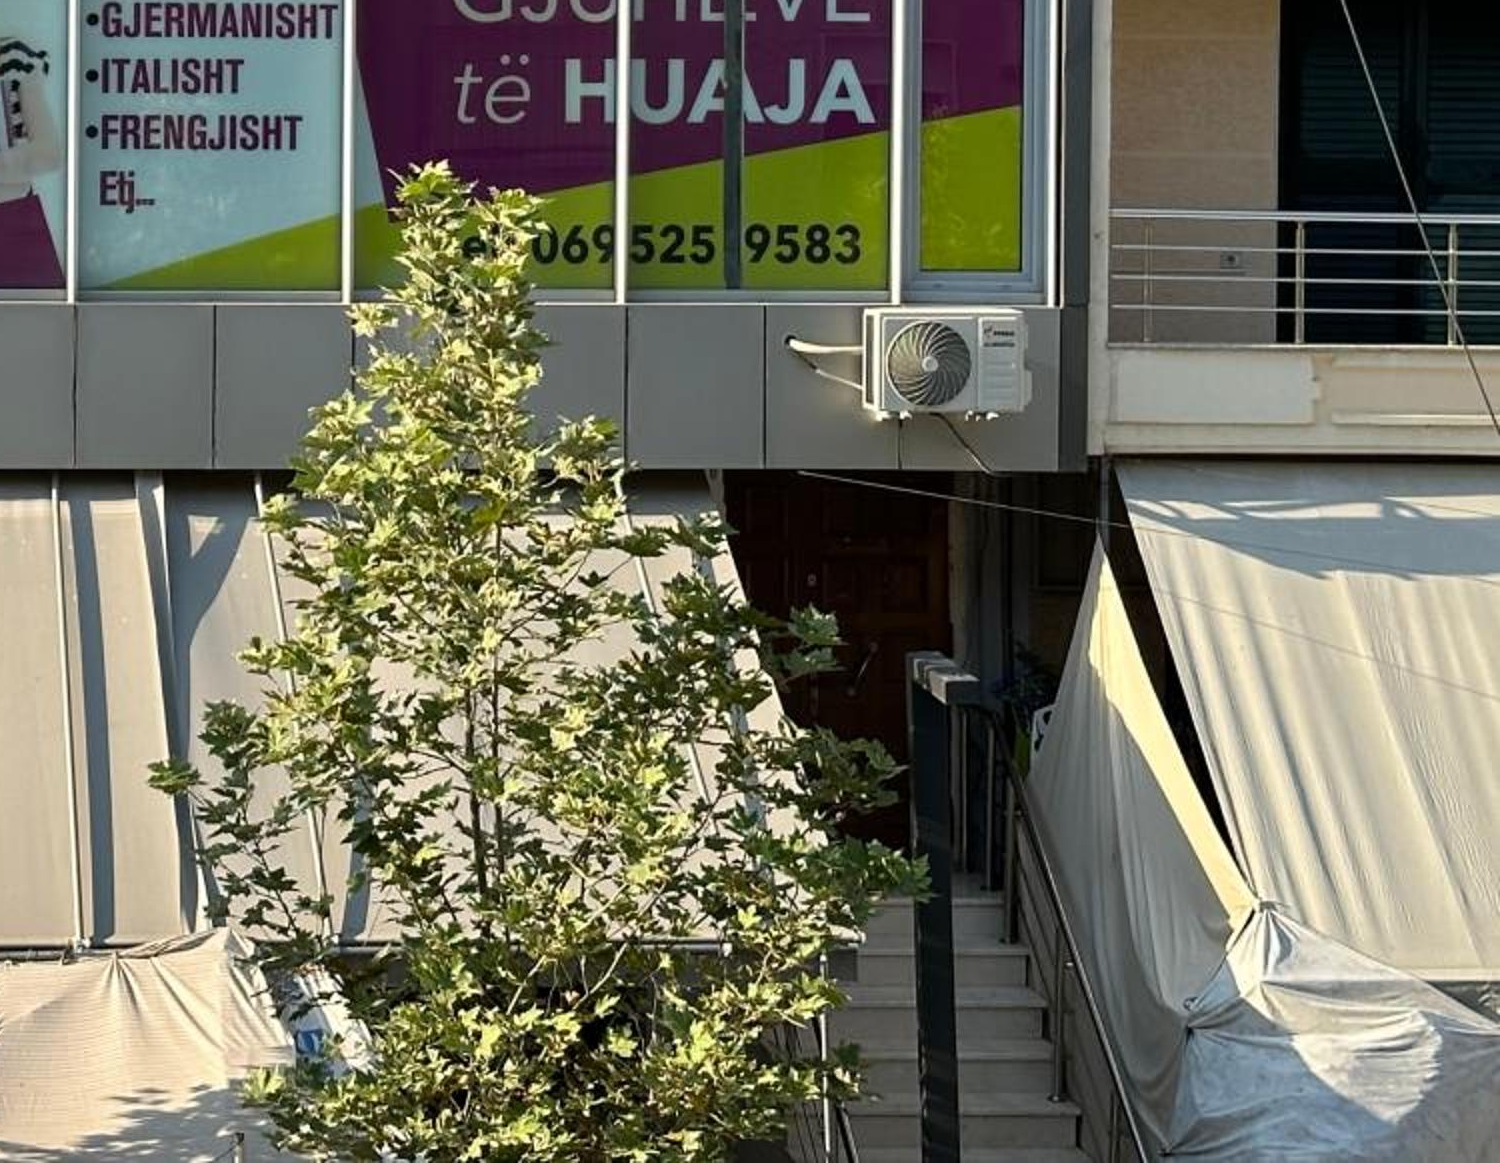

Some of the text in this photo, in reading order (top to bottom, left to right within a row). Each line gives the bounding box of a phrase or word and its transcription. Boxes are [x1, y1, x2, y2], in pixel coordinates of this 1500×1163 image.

[102, 3, 338, 39] GJERMANISHT
[101, 59, 244, 94] ITALISHT
[453, 54, 876, 124] të HUAJA
[101, 115, 303, 150] FRENGJISHT
